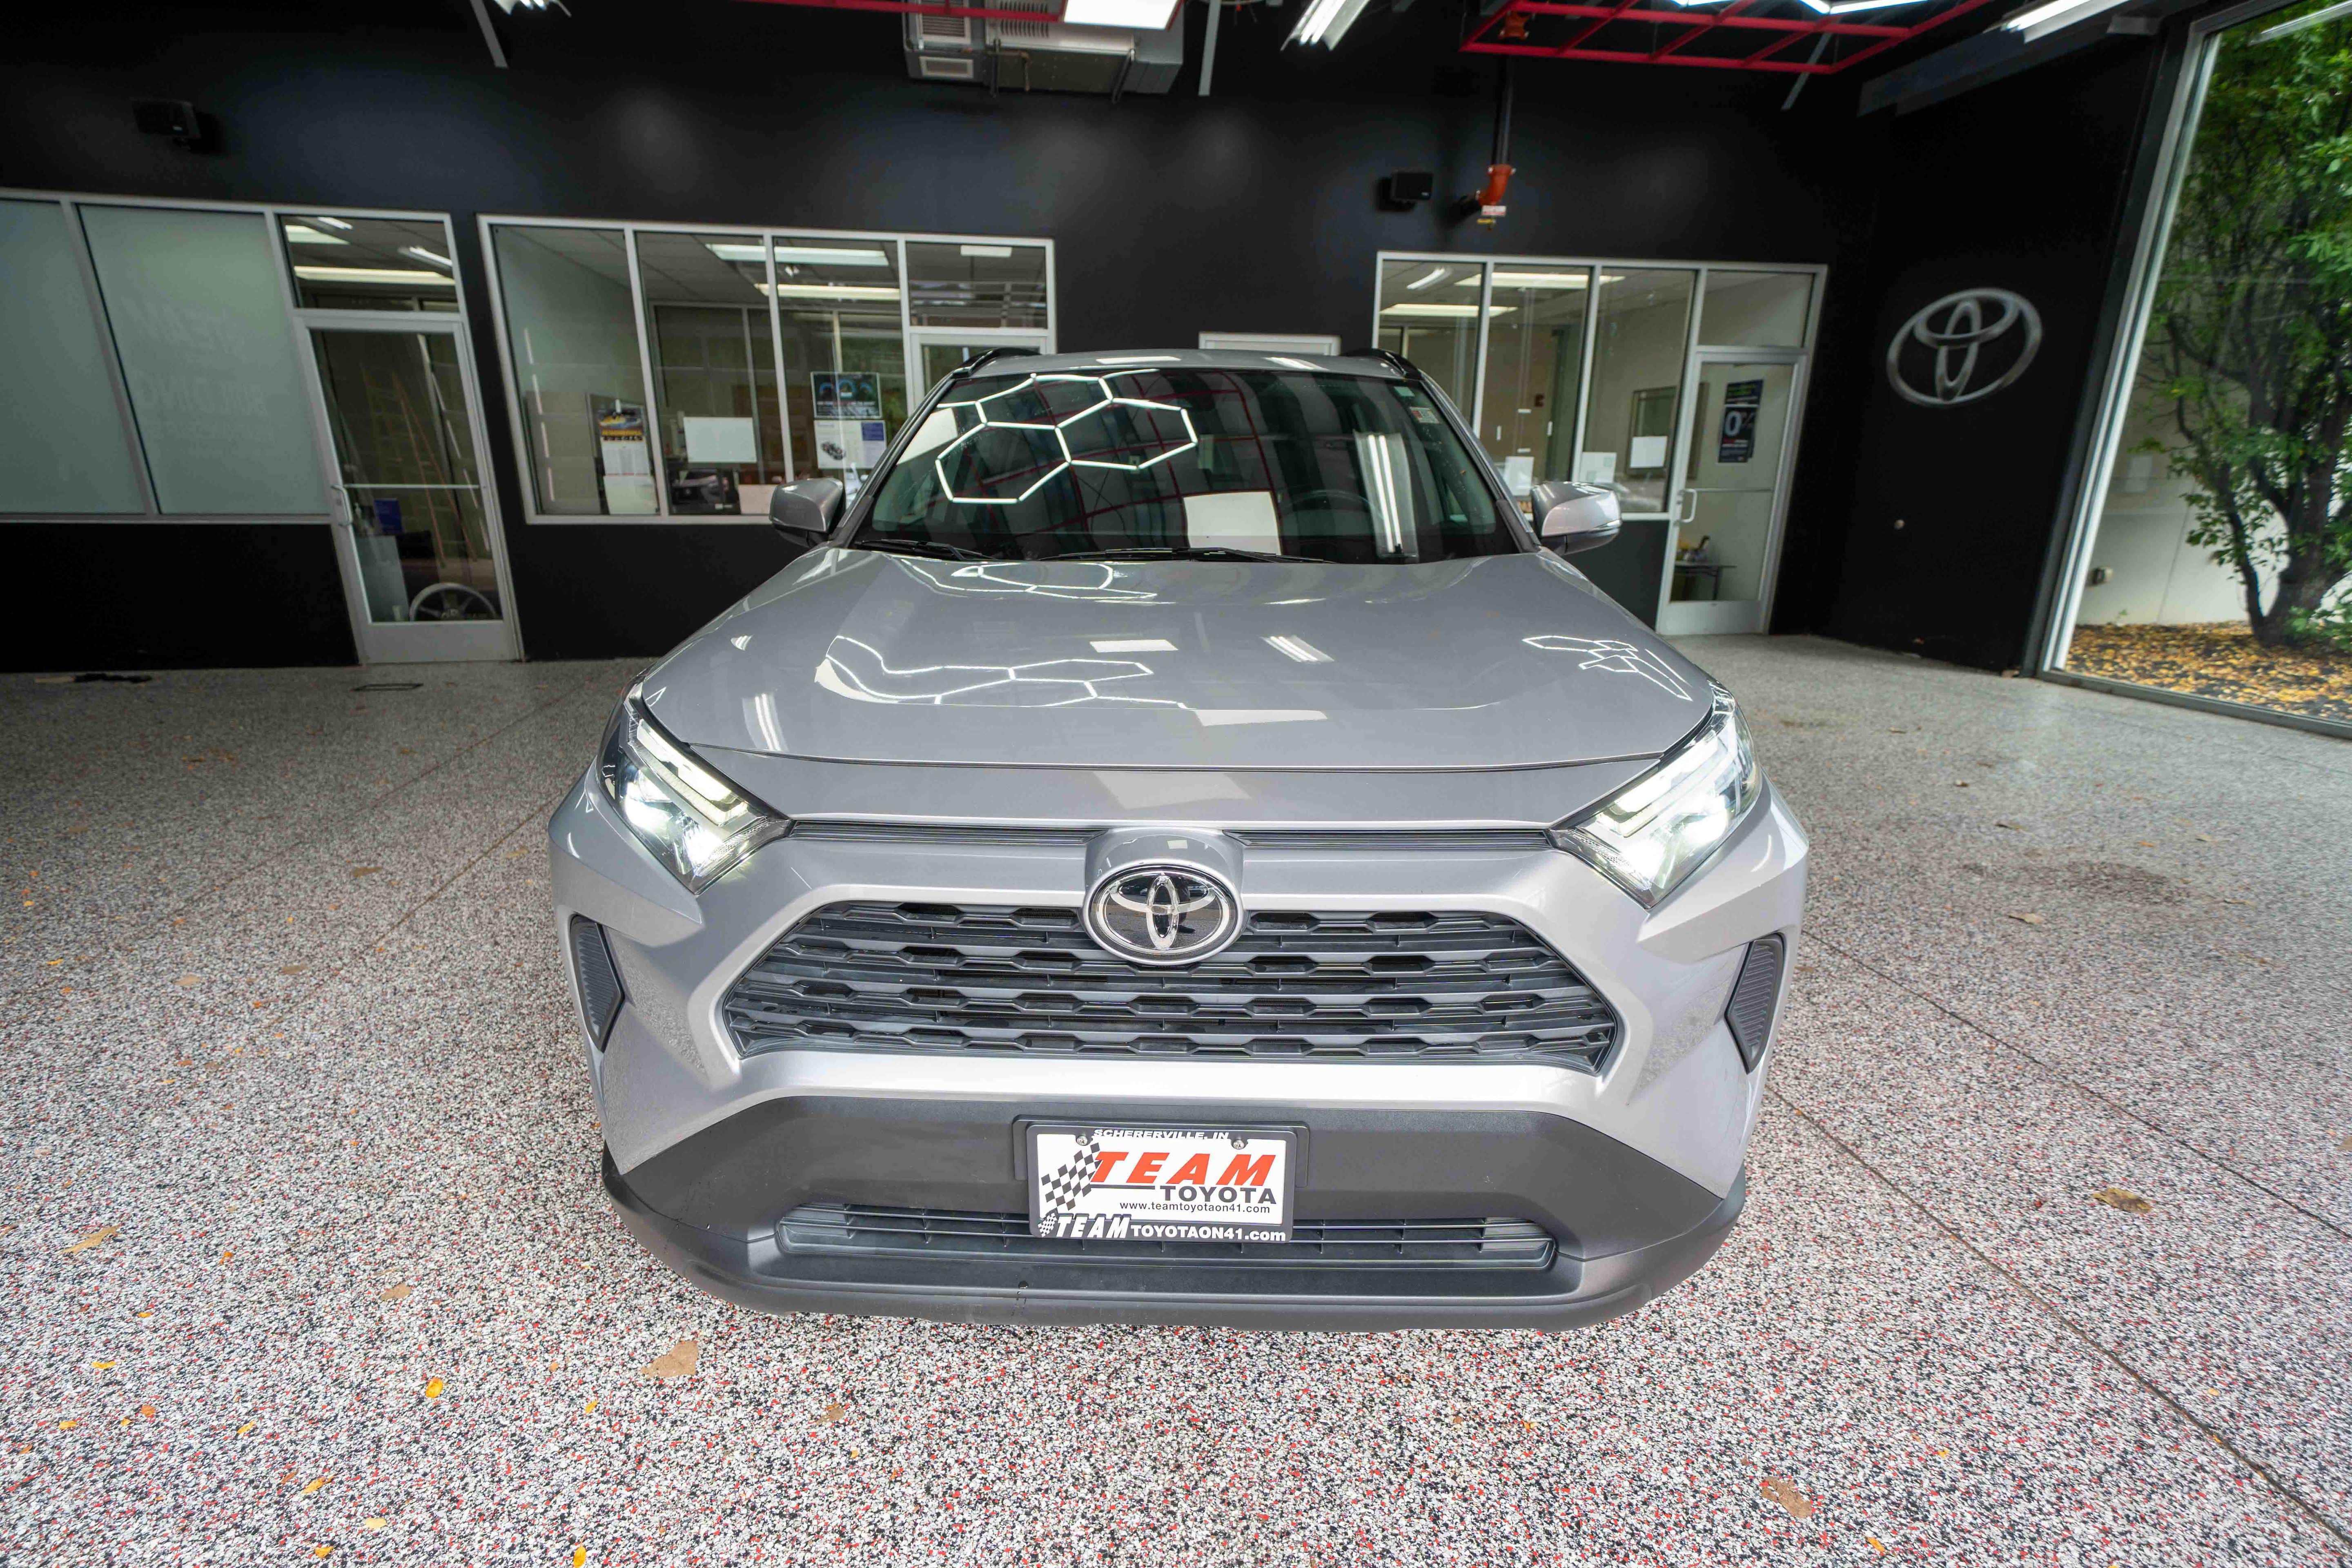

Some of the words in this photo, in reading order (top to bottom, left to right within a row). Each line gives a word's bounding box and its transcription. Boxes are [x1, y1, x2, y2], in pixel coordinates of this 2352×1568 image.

[1090, 1152, 1276, 1186] TEAM
[1160, 1185, 1276, 1205] TOYOTA
[1119, 1201, 1270, 1213] www.teamtoyotaon41.com
[1056, 1216, 1130, 1238] TEAM
[1130, 1225, 1286, 1242] TOYOTAON41.com
